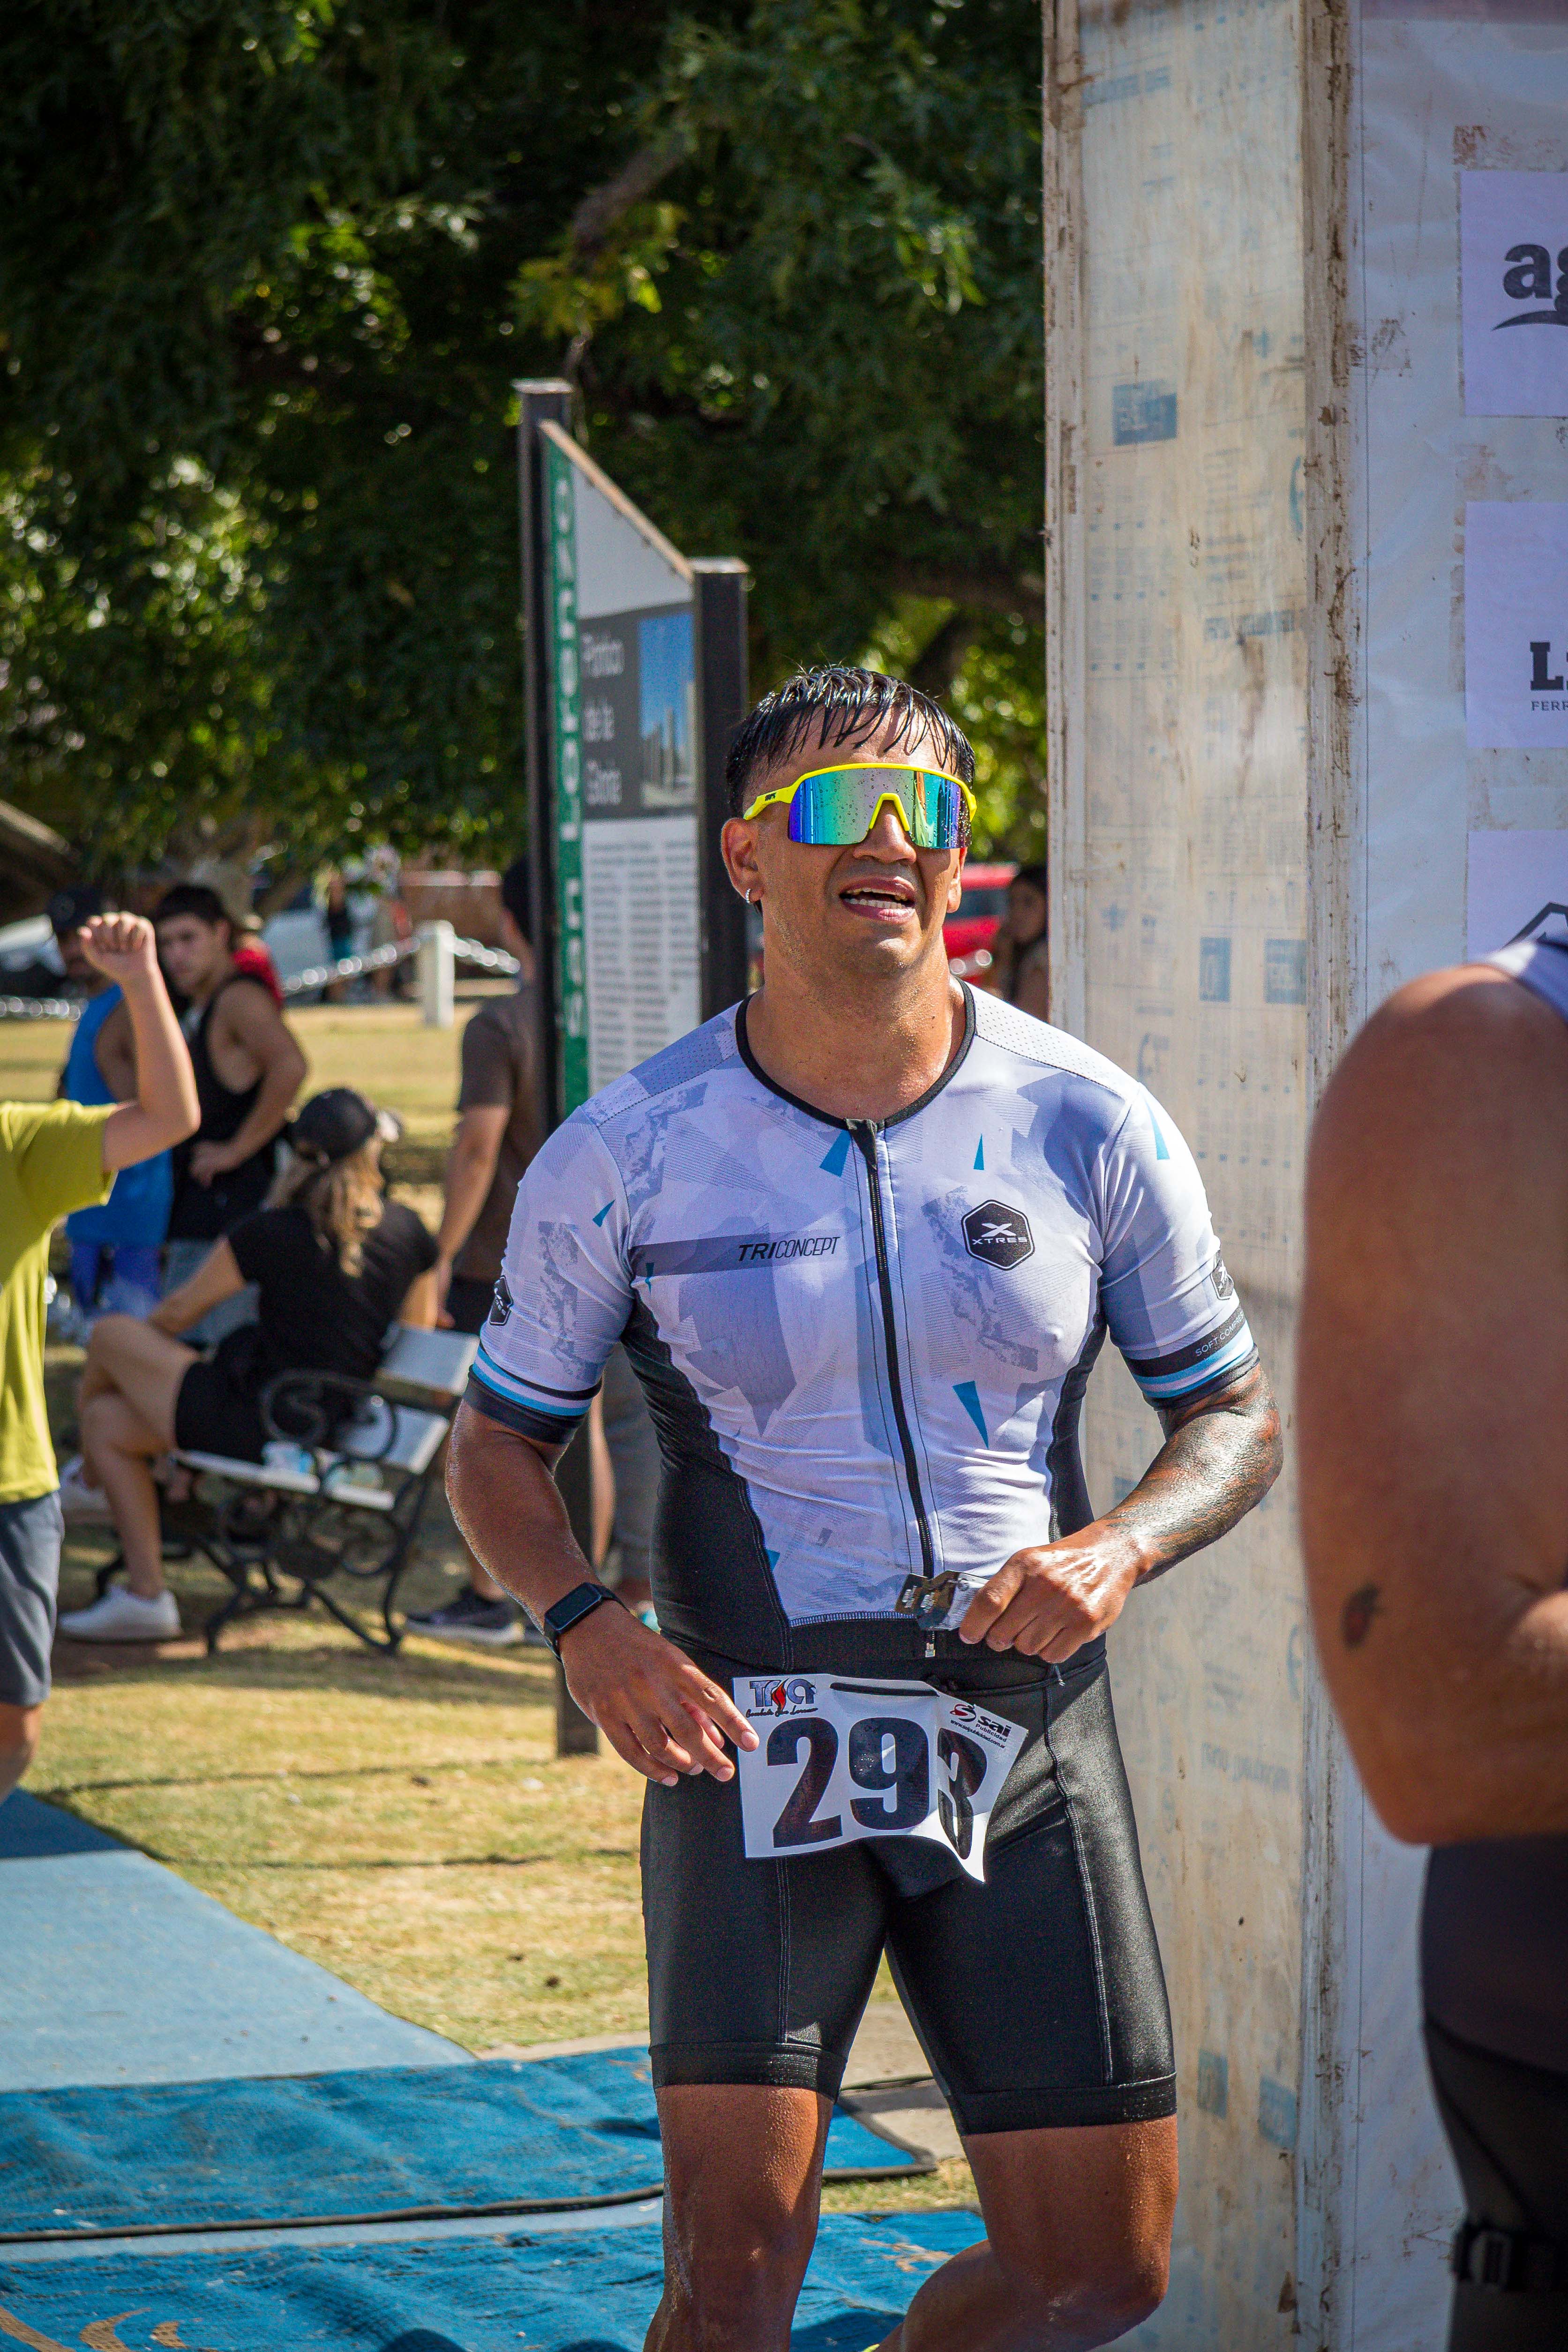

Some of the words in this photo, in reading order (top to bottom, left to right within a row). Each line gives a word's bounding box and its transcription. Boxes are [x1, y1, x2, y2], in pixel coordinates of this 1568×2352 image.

[1503, 244, 1568, 311] a
[1530, 642, 1568, 691] L
[738, 1236, 840, 1261] TRICONCEPT
[972, 1236, 1028, 1245] XTRES
[1195, 1337, 1218, 1356] SOFT
[975, 1723, 1007, 1742] Publicidad
[977, 1715, 1012, 1738] sai
